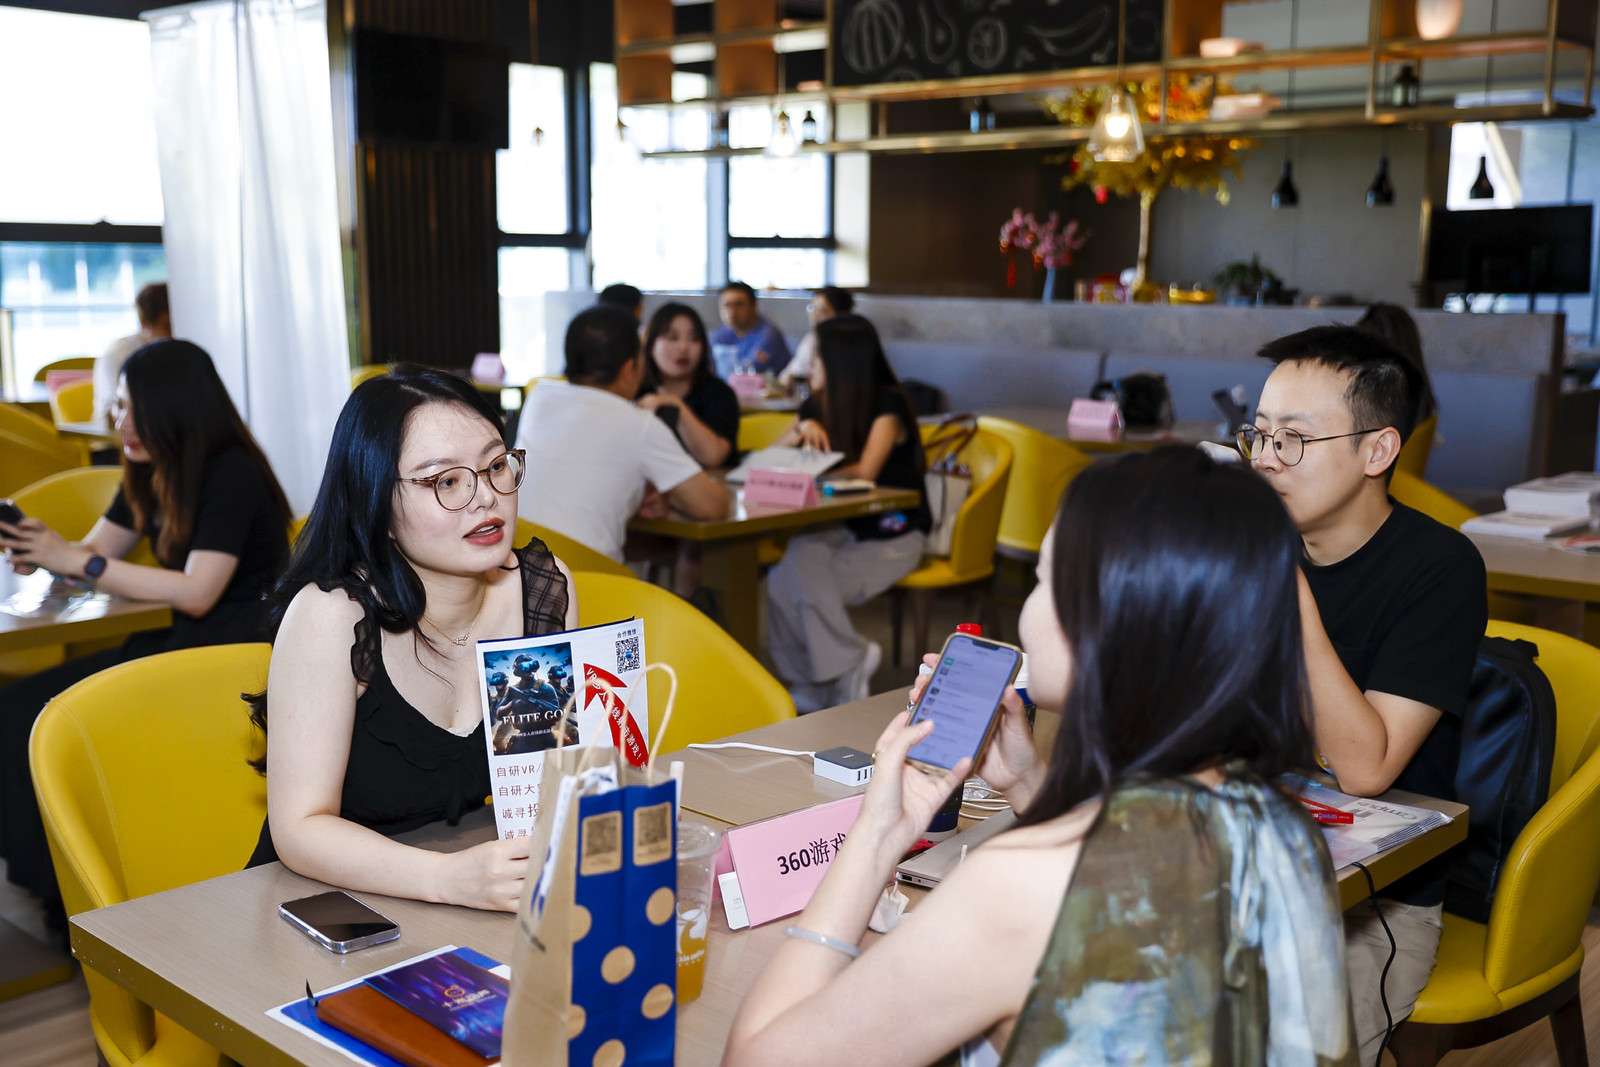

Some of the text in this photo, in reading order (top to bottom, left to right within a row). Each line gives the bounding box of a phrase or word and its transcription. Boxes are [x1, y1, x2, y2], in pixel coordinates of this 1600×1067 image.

[502, 711, 541, 725] ELITE
[499, 783, 541, 797] 自研大
